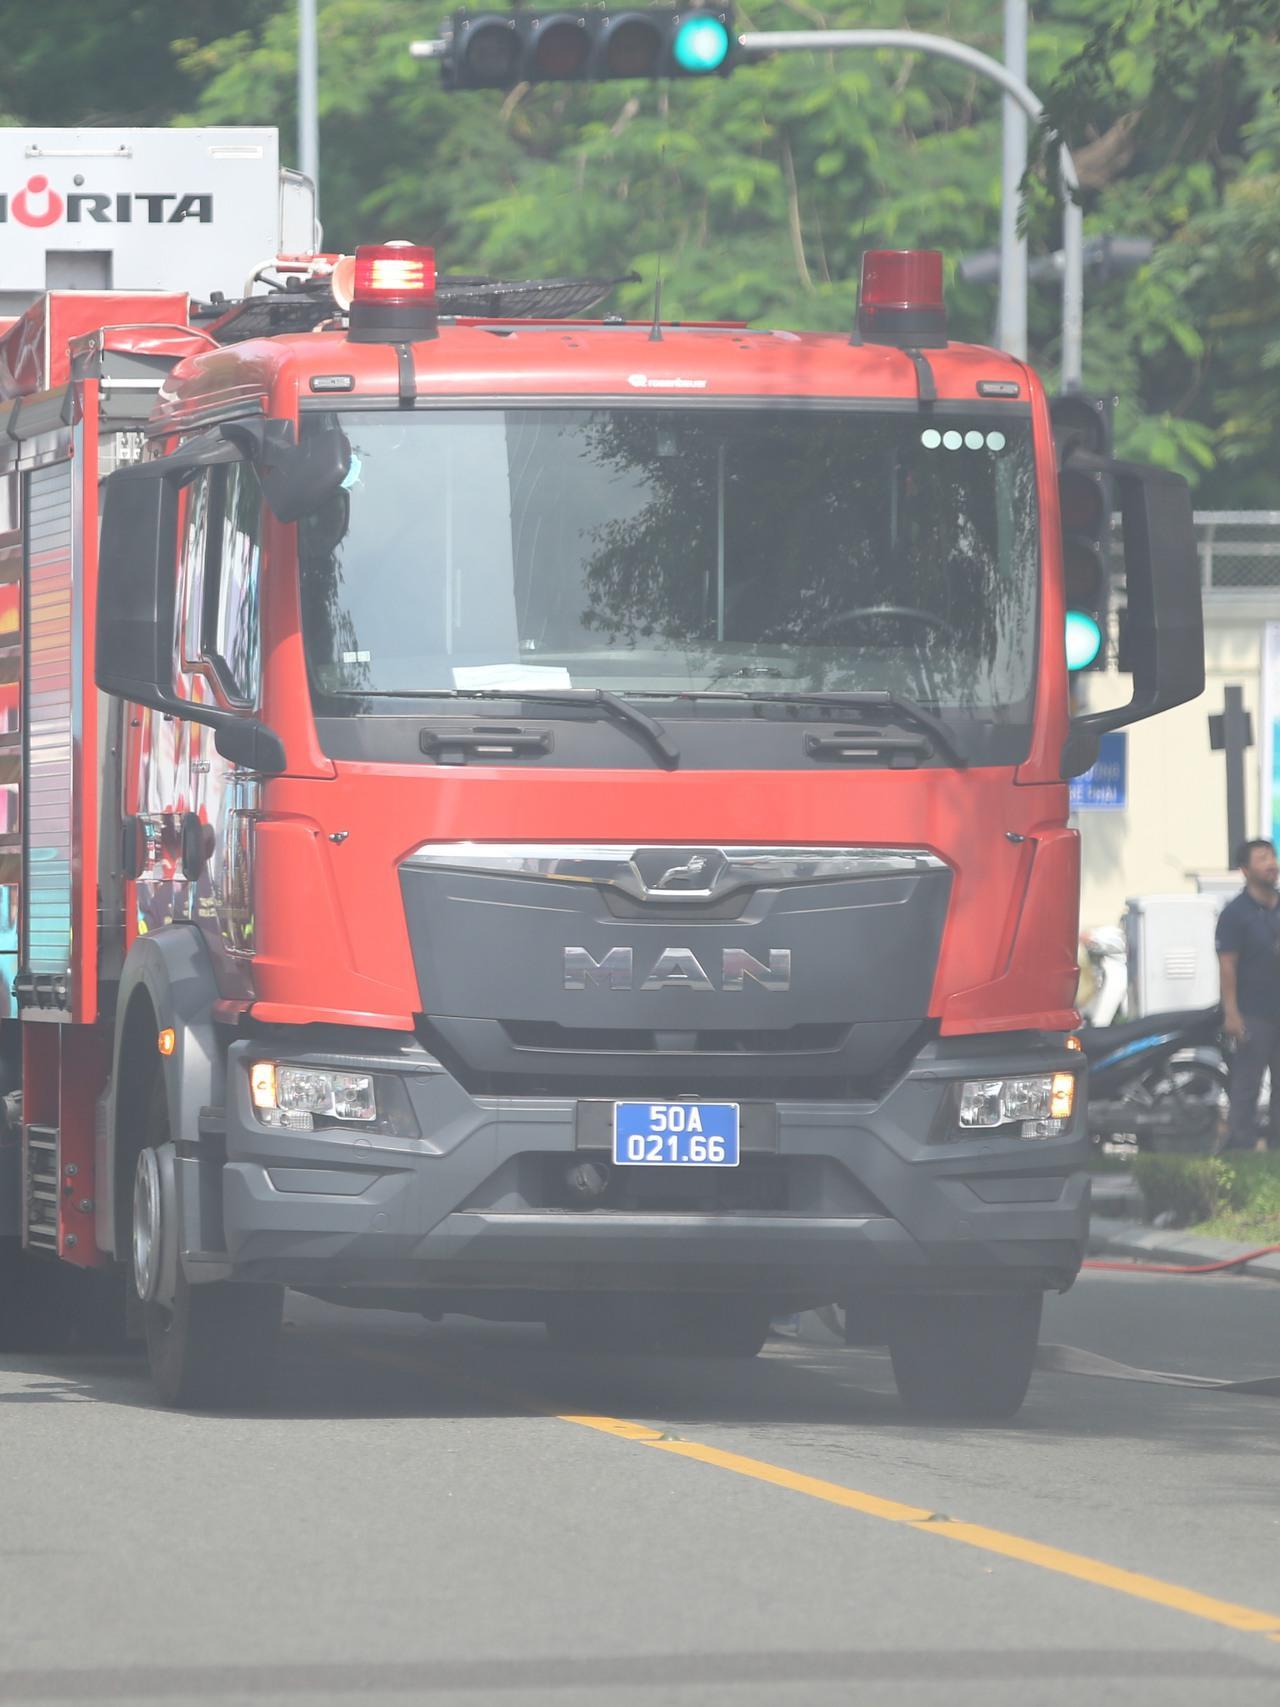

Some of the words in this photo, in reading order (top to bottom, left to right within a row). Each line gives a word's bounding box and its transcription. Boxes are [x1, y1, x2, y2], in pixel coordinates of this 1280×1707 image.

[564, 947, 791, 991] MAN
[649, 1106, 703, 1132] 50A
[628, 1135, 725, 1162] 021.66
